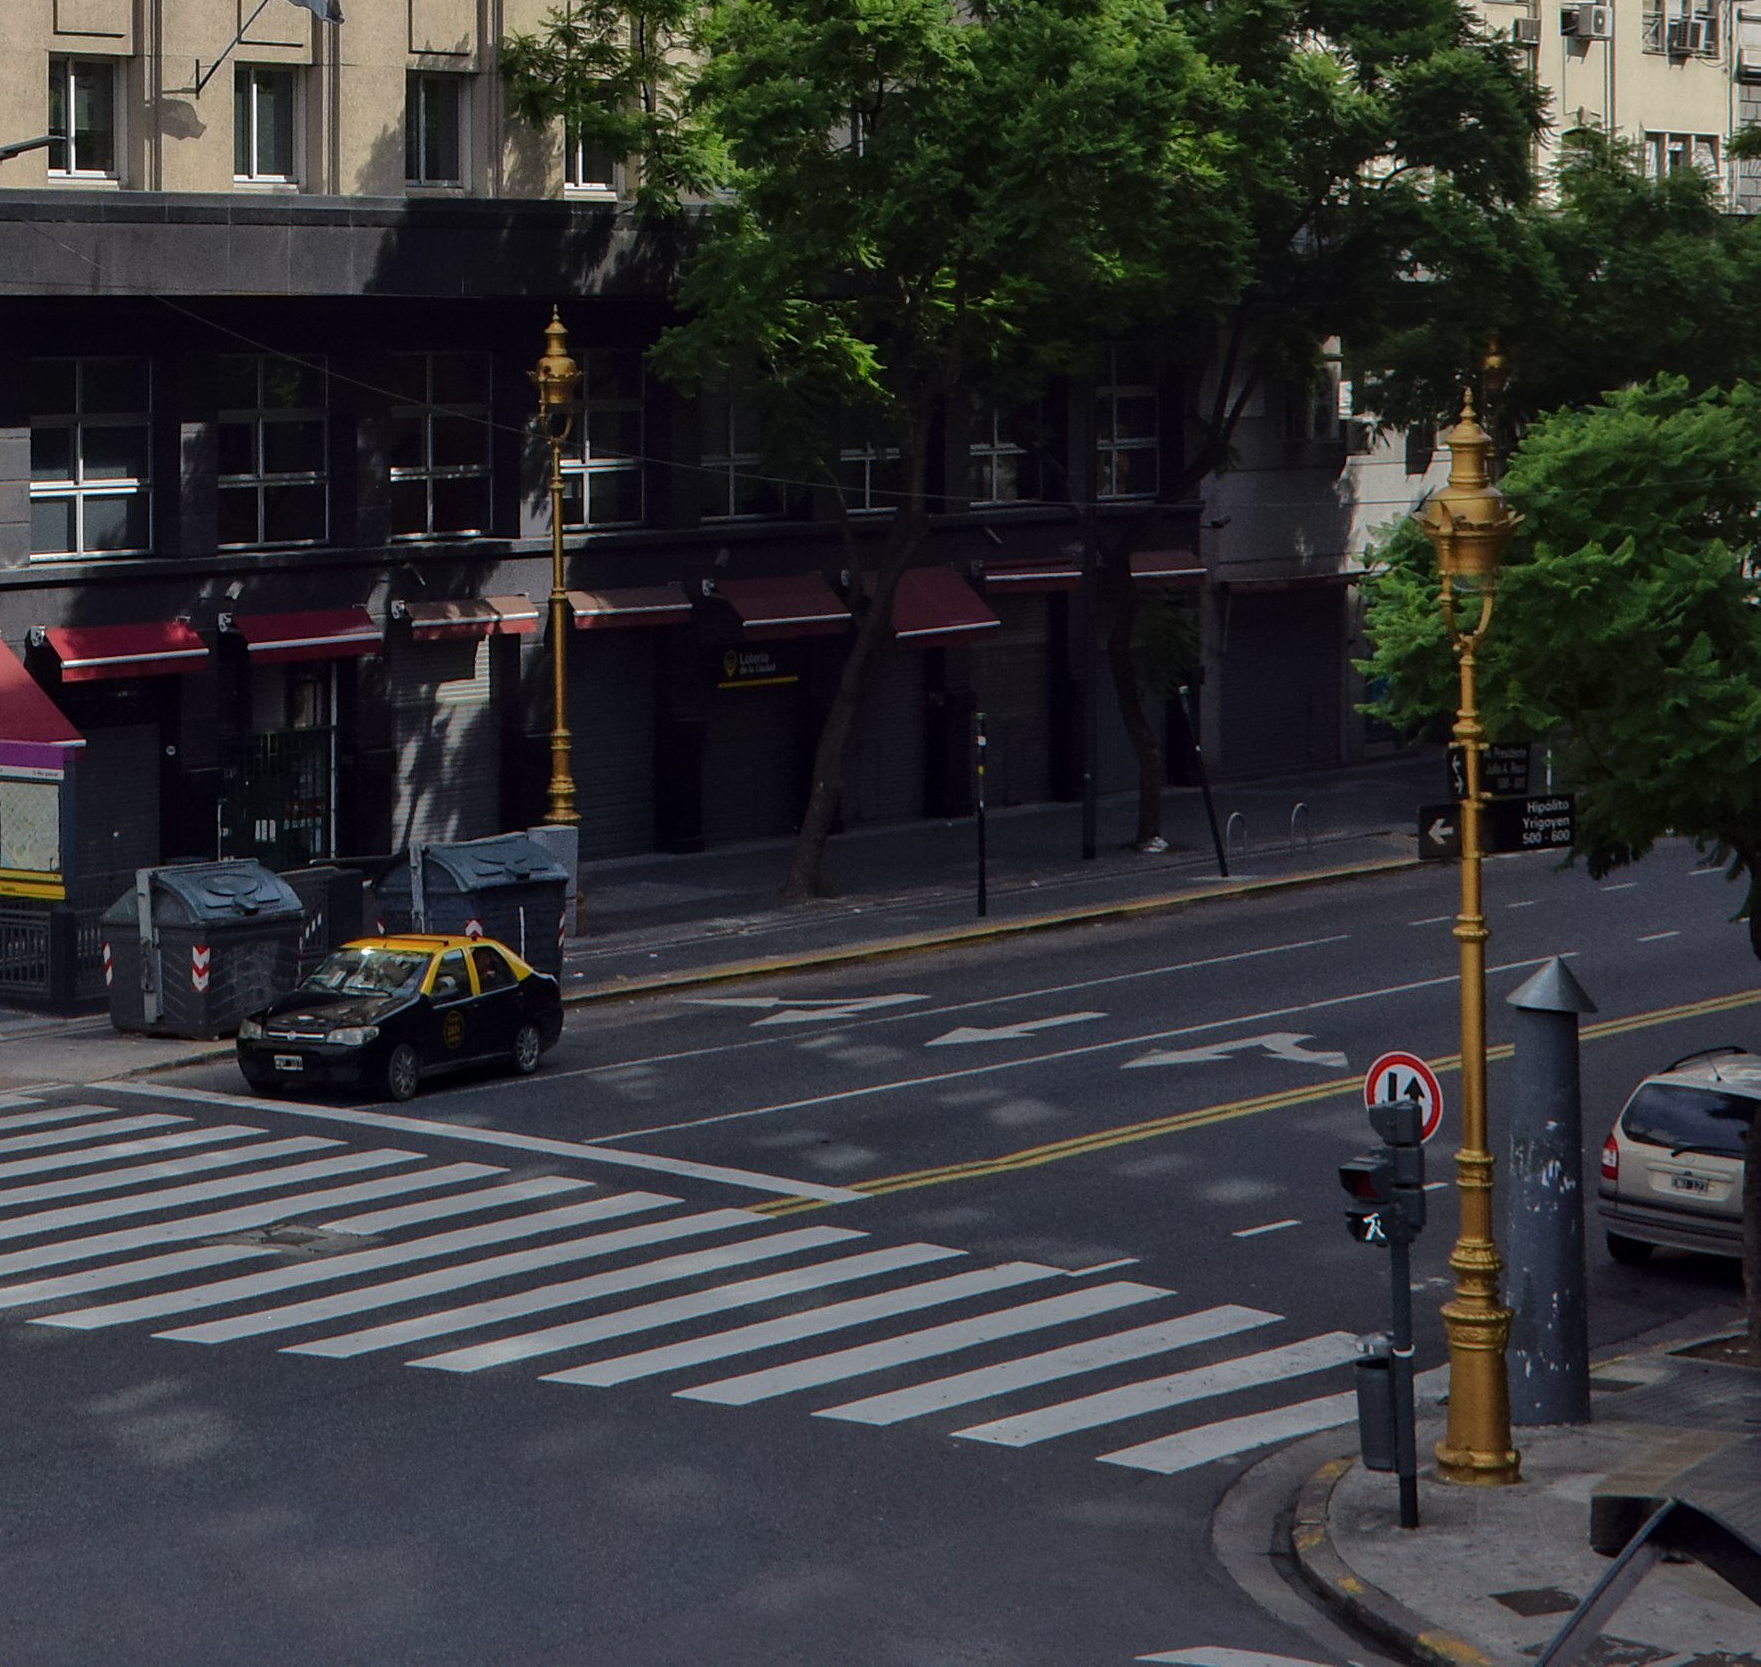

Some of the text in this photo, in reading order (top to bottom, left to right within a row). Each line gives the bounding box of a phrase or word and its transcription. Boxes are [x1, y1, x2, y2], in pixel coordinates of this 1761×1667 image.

[1527, 798, 1570, 815] Hipólito
[1522, 816, 1570, 831] Yrigoyen
[1522, 831, 1542, 845] 500
[1551, 829, 1570, 842] 600
